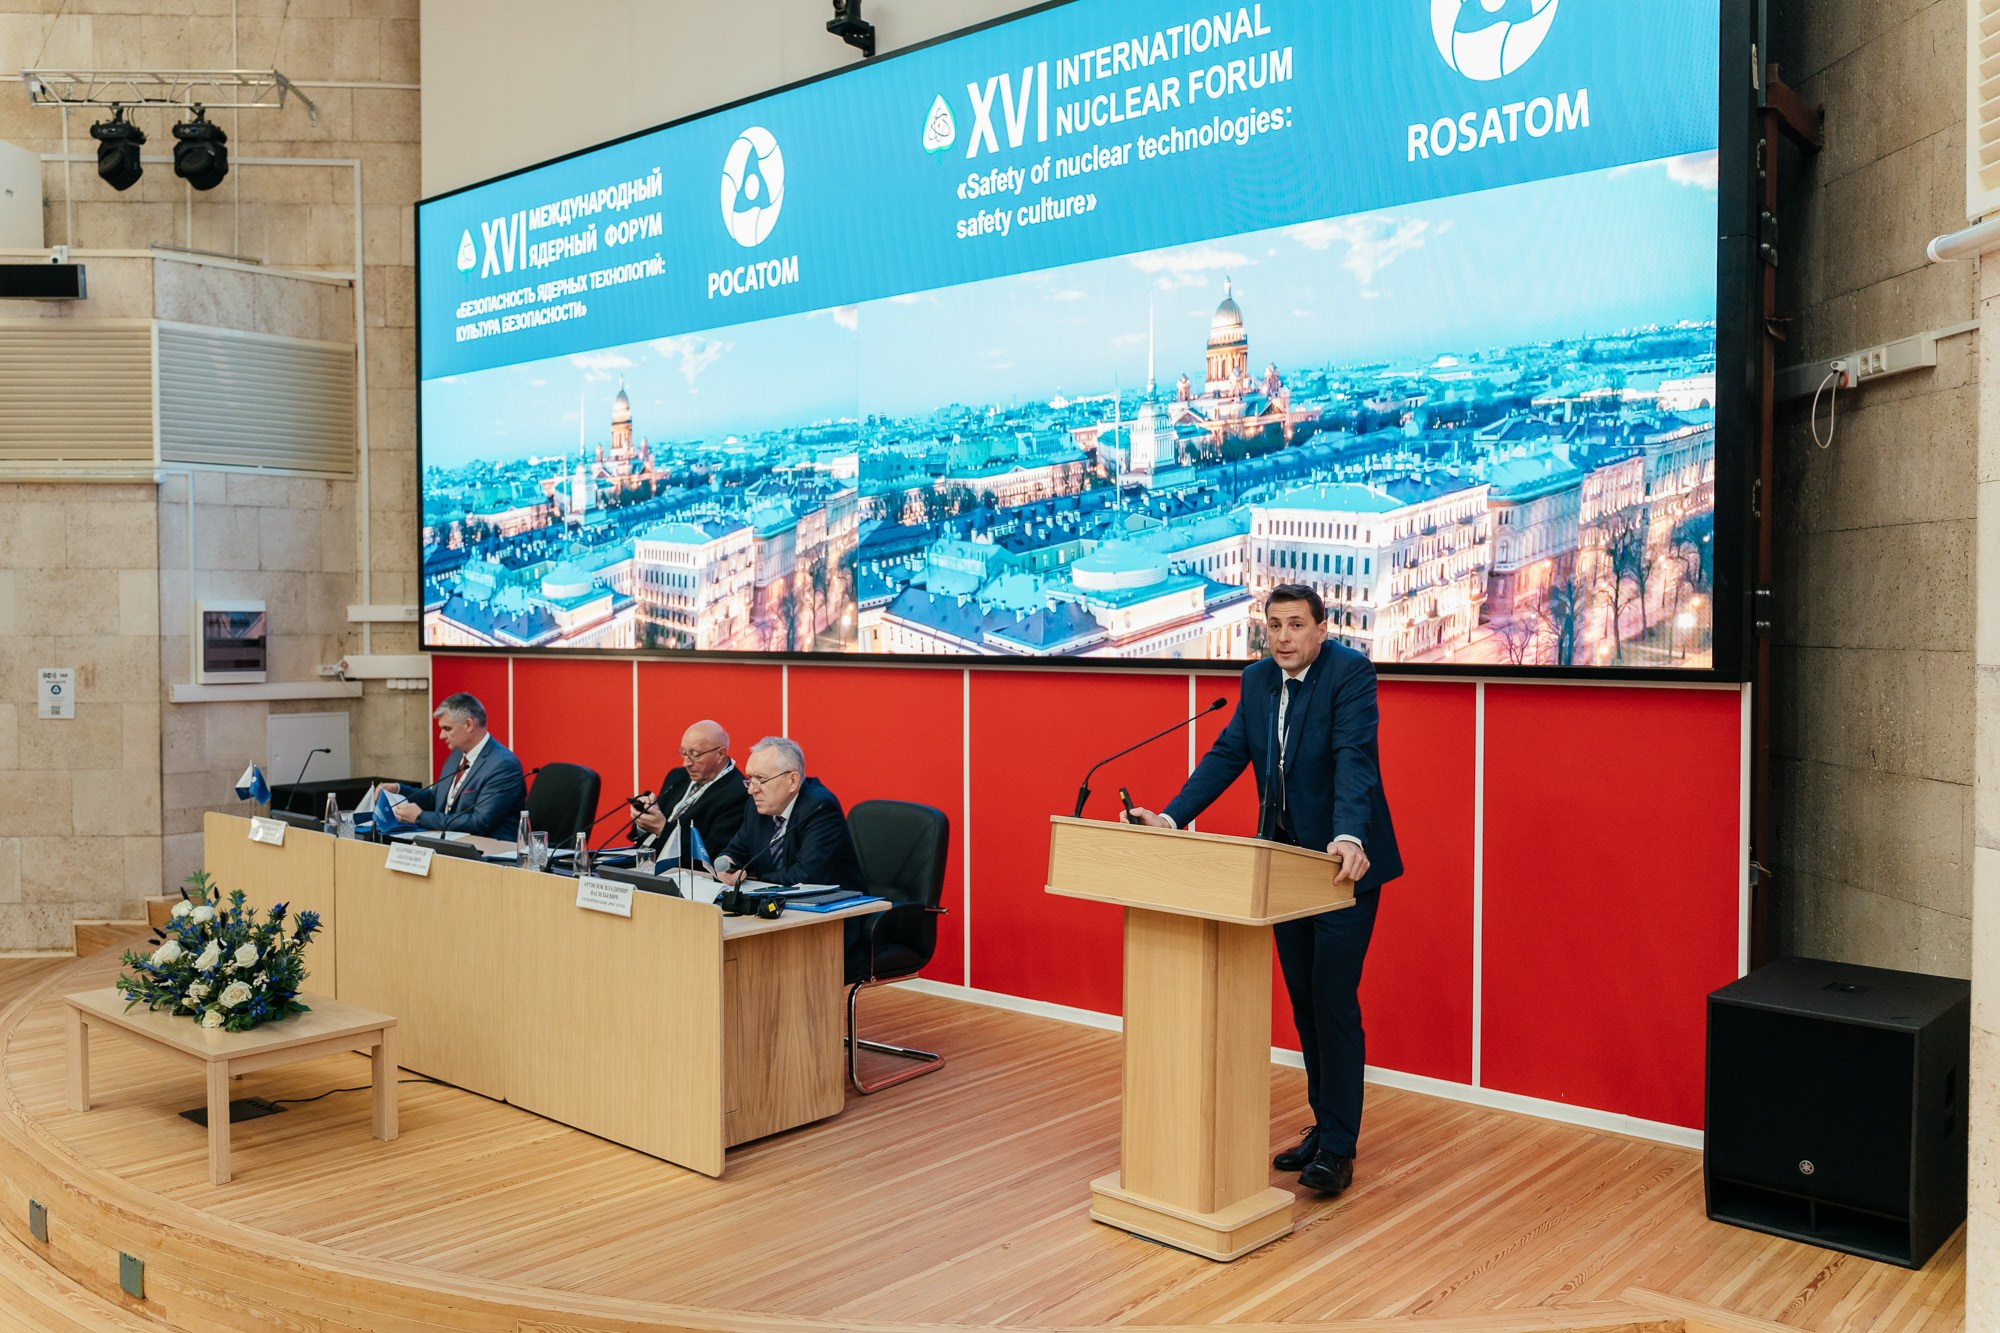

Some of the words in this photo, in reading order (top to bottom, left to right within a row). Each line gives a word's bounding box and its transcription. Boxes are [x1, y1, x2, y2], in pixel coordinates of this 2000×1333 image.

[1055, 3, 1271, 90] INTERNATIONAL
[965, 60, 1048, 159] XVI
[1055, 76, 1180, 137] NUCLEAR
[1188, 46, 1293, 100] FORUM
[956, 166, 1027, 201] «Safety
[1030, 155, 1052, 185] of
[1055, 141, 1132, 179] nuclear
[1136, 105, 1293, 161] technologies:
[1407, 88, 1590, 163] ROSATOM
[528, 166, 663, 231] МЕЖДУНАРОДНЫЙ
[956, 206, 1013, 240] safety
[1016, 191, 1098, 227] culture»
[480, 210, 527, 279] XVI
[528, 223, 598, 269] ЯДЕРНЫЙ
[604, 212, 663, 249] ФОРУМ
[537, 274, 588, 304] ЯДЕРНЫХ
[707, 254, 799, 300] РОСАТОМ
[455, 318, 501, 343] КУЛЬТУРА
